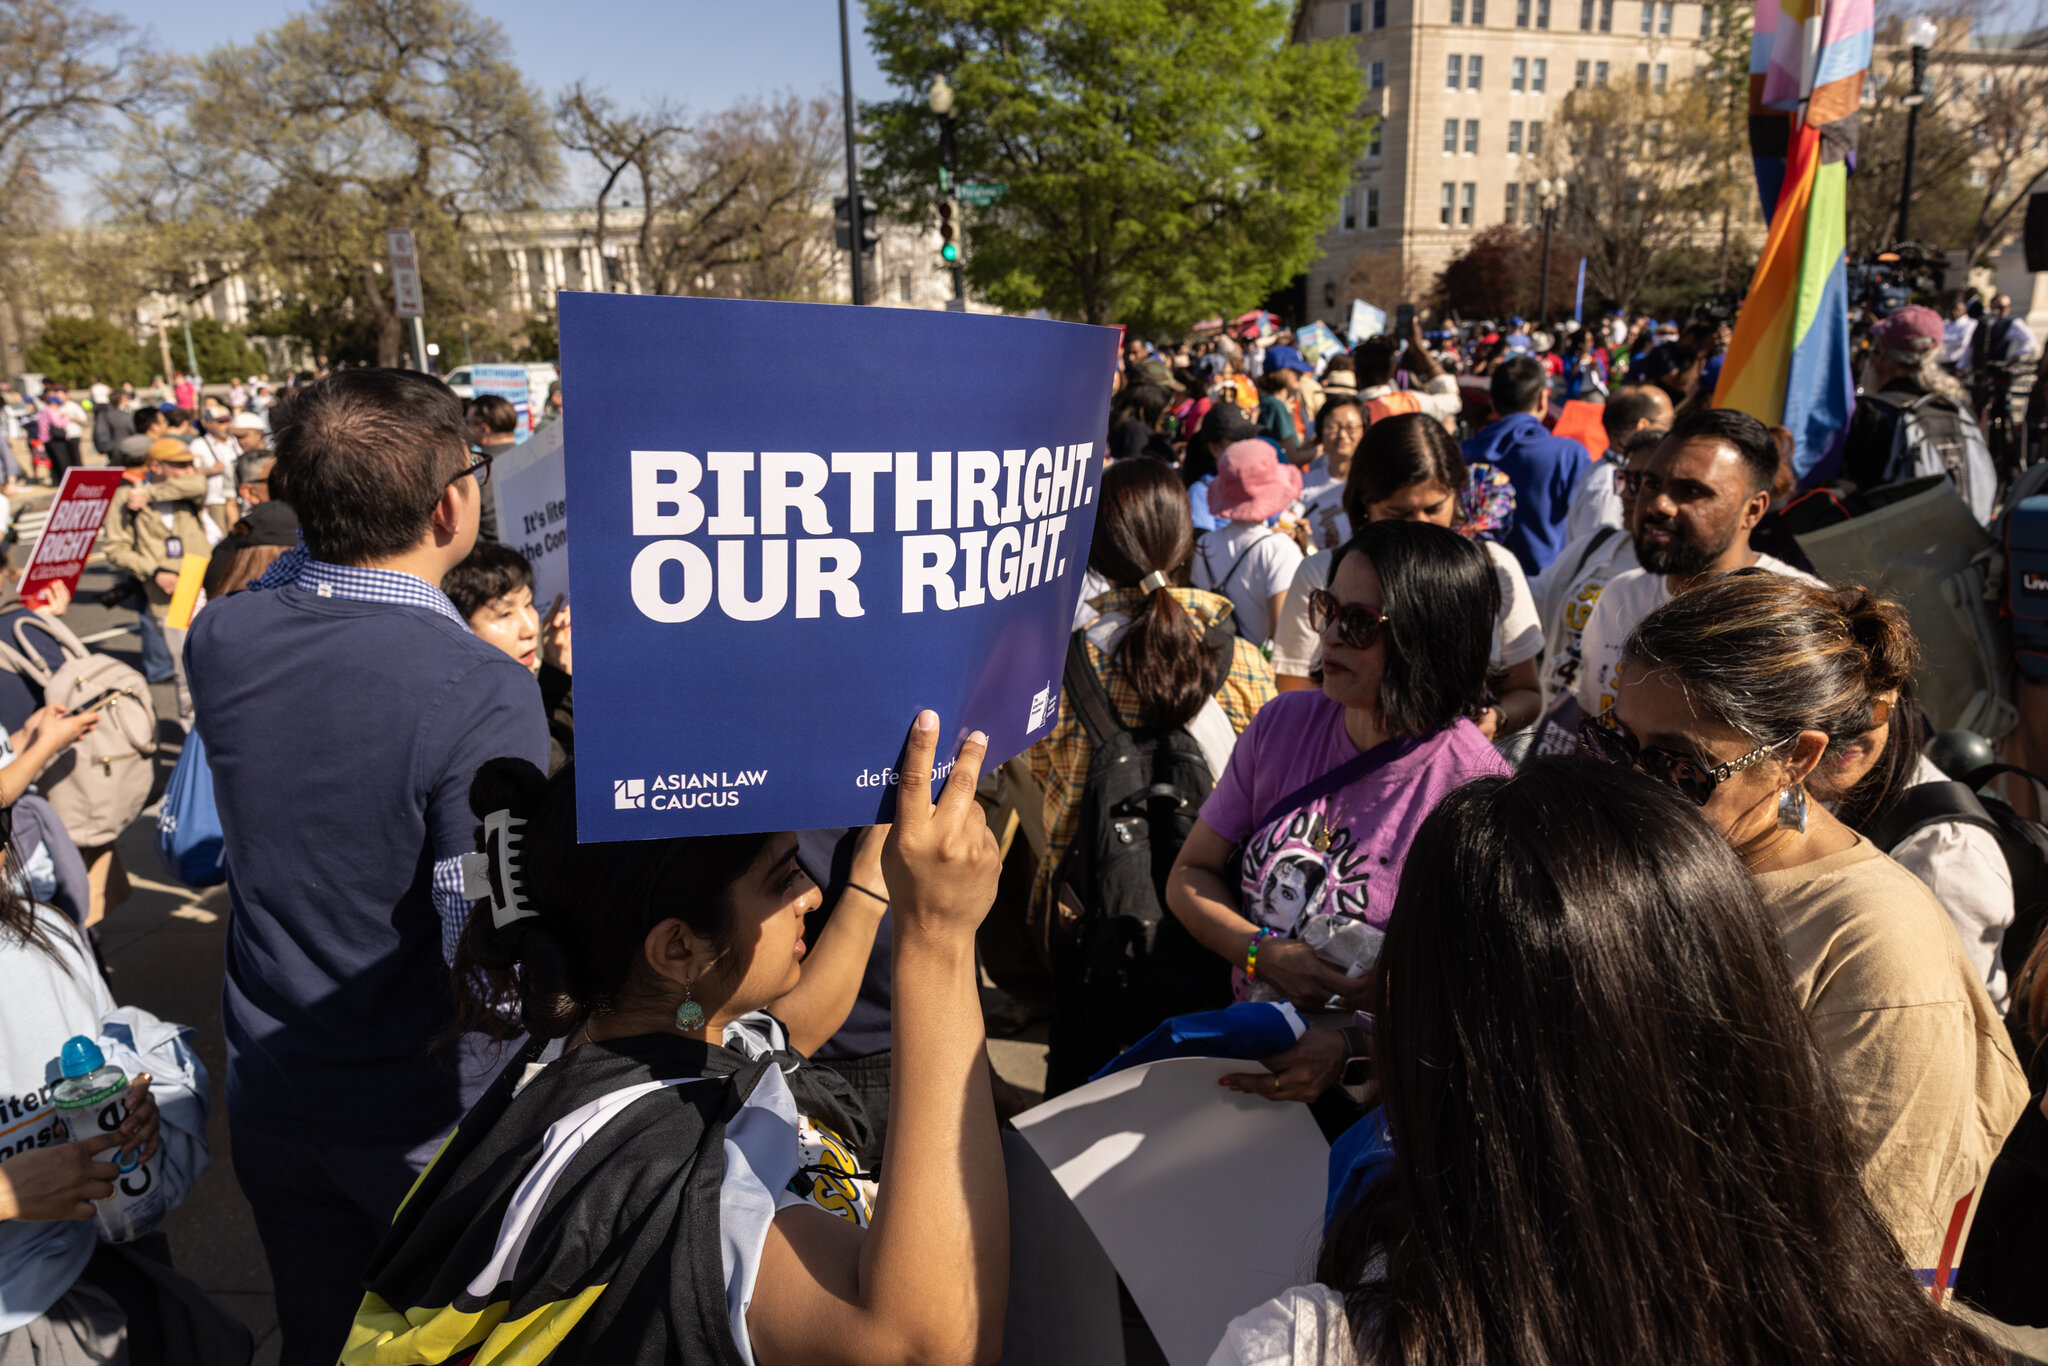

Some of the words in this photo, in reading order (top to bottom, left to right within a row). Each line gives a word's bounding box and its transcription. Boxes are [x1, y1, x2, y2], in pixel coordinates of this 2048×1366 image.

[631, 441, 1093, 536] BIRTHRIGHT.
[49, 499, 109, 531] BIRTH
[523, 510, 546, 534] It's
[545, 500, 567, 524] lite
[35, 530, 97, 564] RIGHT
[544, 529, 567, 552] Con
[631, 538, 866, 624] OUR
[902, 514, 1068, 614] RIGHT.
[651, 773, 718, 791] ASIAN
[721, 770, 768, 788] LAW
[651, 791, 740, 811] CAUCUS
[1241, 811, 1370, 923] DECOLONIZ
[0, 1078, 64, 1125] iter
